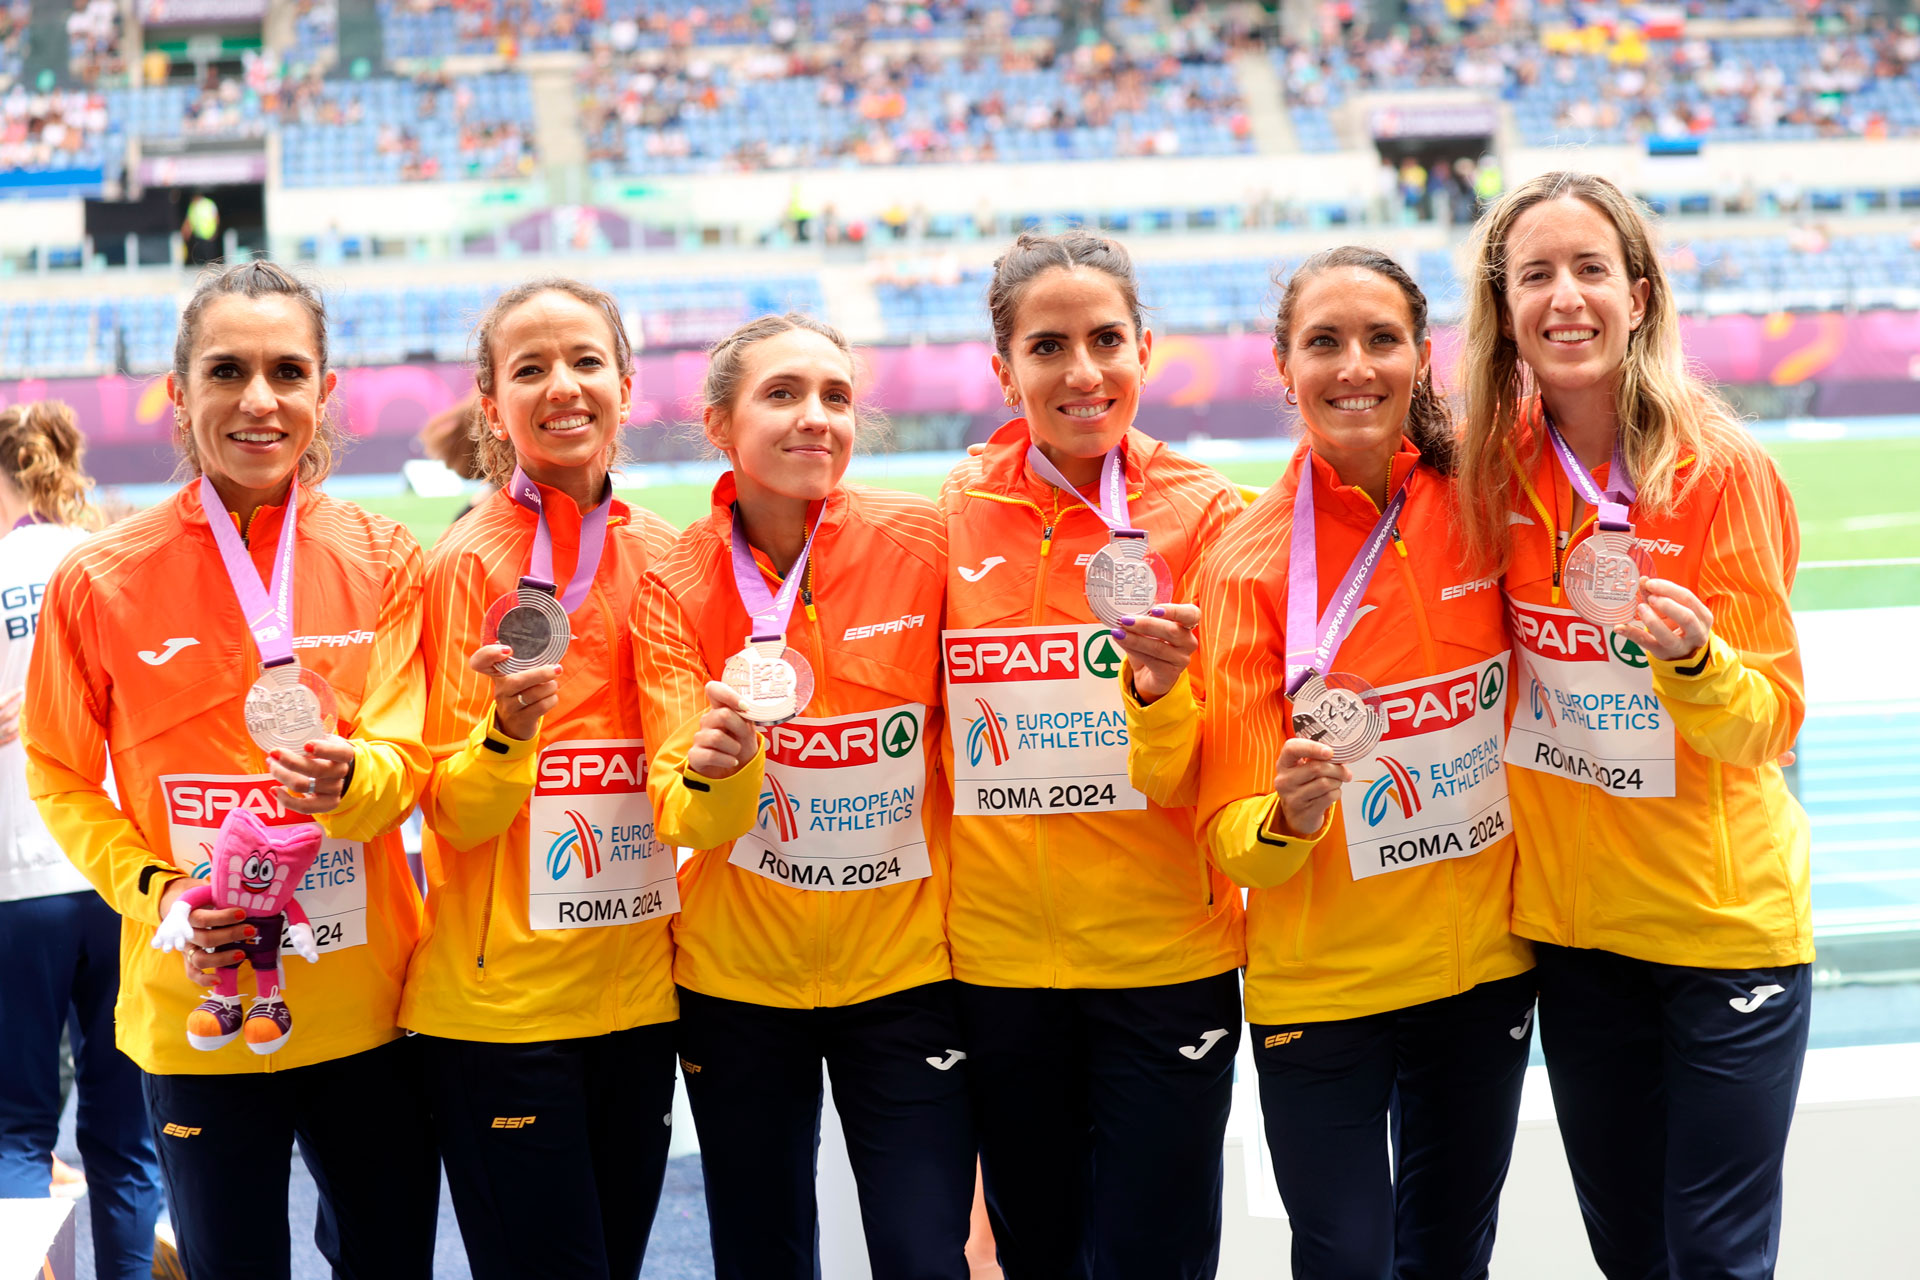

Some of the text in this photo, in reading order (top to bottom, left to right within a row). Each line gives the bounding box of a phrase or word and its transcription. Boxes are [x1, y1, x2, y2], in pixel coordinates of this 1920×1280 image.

[1634, 538, 1685, 557] AÑA
[1322, 606, 1347, 649] EUROPEAN
[1342, 564, 1368, 609] ATHLETICS
[292, 629, 375, 649] ESPAÑA
[843, 614, 925, 641] ESPAÑA
[950, 639, 1075, 677] SPAR
[1372, 681, 1475, 734] PAR
[1554, 689, 1659, 711] EUROPEAN
[1016, 710, 1127, 731] EUROPEAN
[1562, 709, 1660, 730] ATHLETICS
[1018, 729, 1129, 750] ATHLETICS
[1430, 734, 1498, 781] EUROPEAN
[1535, 742, 1644, 790] ROMA 2024
[1432, 754, 1500, 799] ATHLETICS
[172, 786, 286, 820] SPA
[810, 785, 915, 814] EUROPEAN
[977, 783, 1117, 810] ROMA 2024
[809, 804, 912, 831] ATHLETICS
[1379, 810, 1505, 868] ROMA 2024
[759, 849, 901, 886] ROMA 2024
[559, 889, 662, 923] ROMA 2024
[1265, 1031, 1304, 1049] ESP
[162, 1122, 202, 1139] ESP
[491, 1116, 537, 1129] ESP
